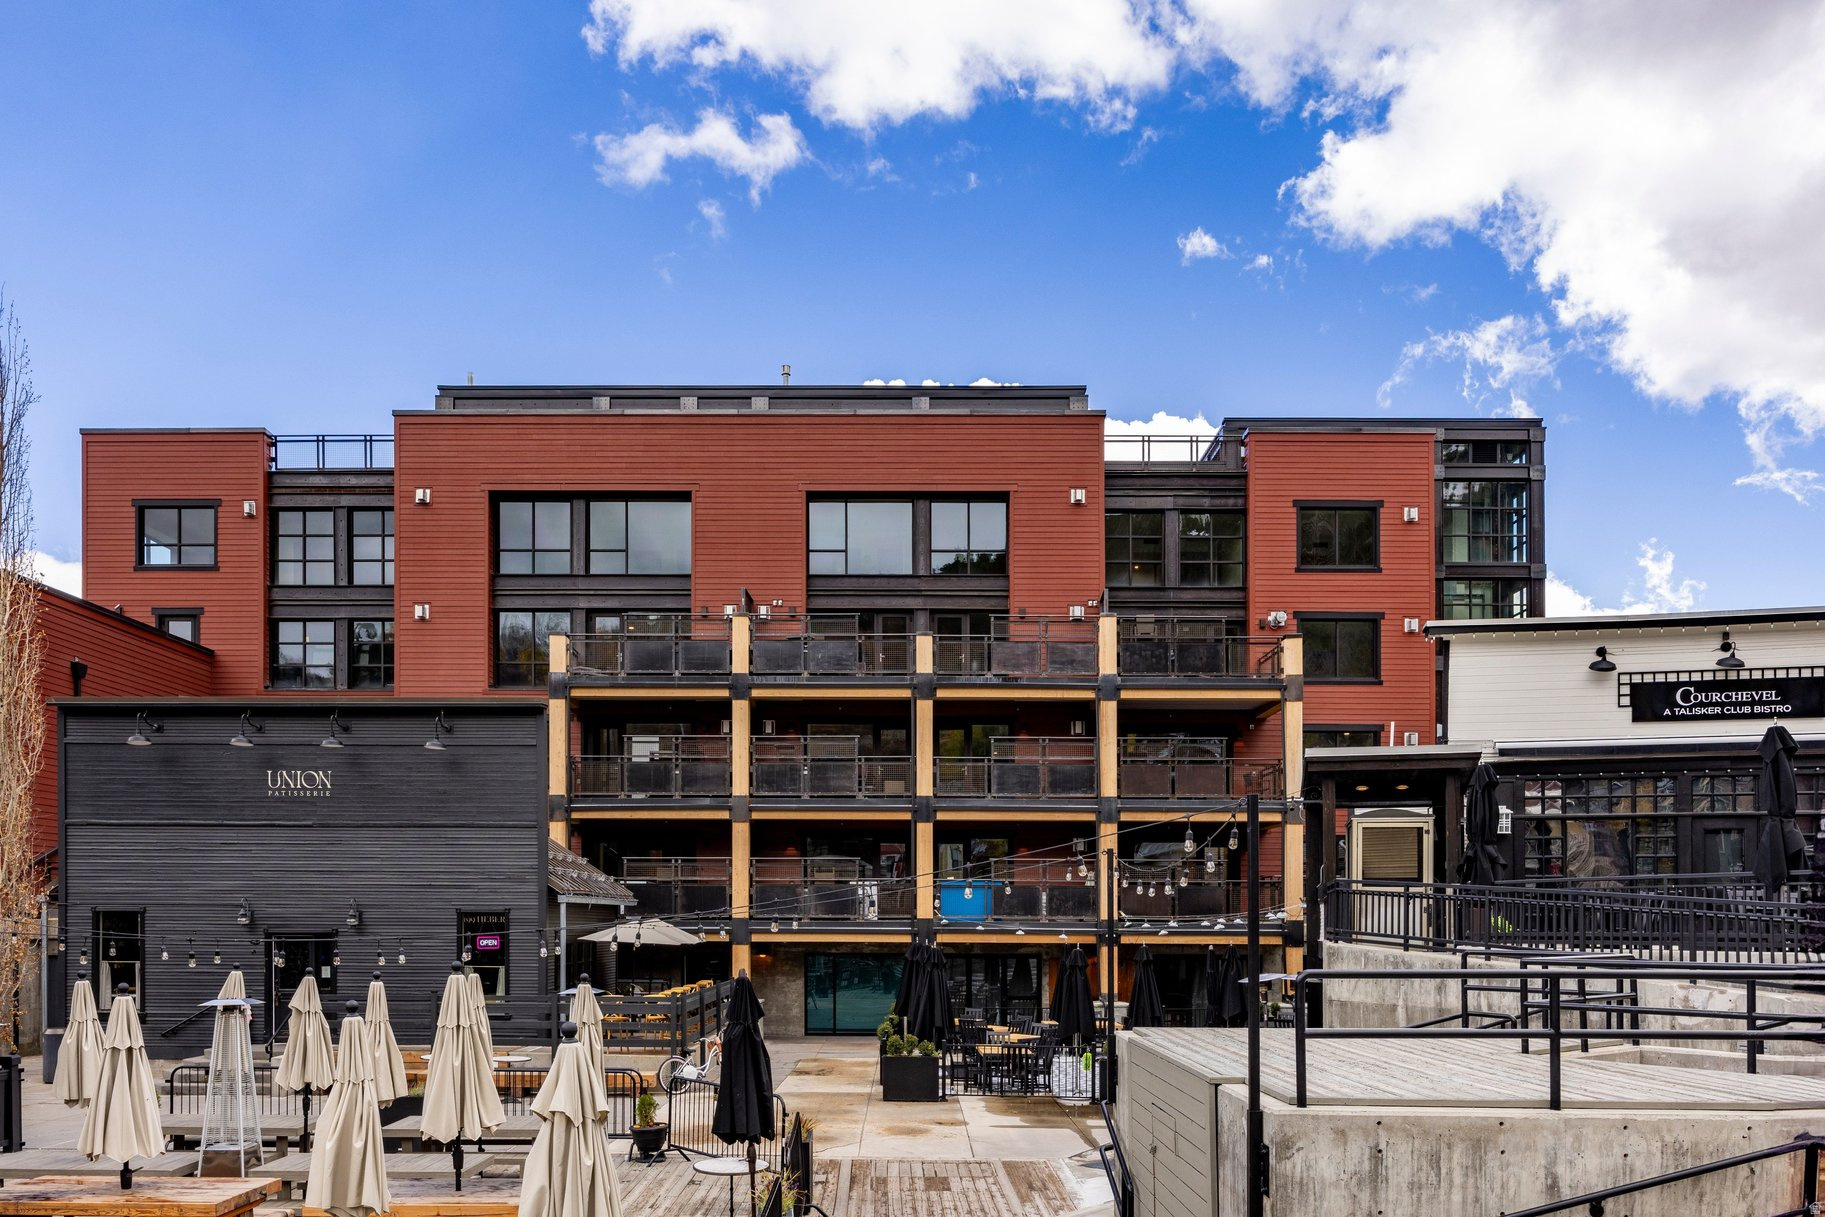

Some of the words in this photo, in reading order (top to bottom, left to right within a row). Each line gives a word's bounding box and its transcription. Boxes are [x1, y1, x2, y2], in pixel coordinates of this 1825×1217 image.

[1675, 686, 1781, 706] COURCHEVEL
[1663, 708, 1672, 716] A
[1674, 706, 1722, 716] TALISKER
[1723, 705, 1752, 714] CLUB
[1753, 704, 1792, 714] BISTRO
[266, 770, 332, 789] UNION
